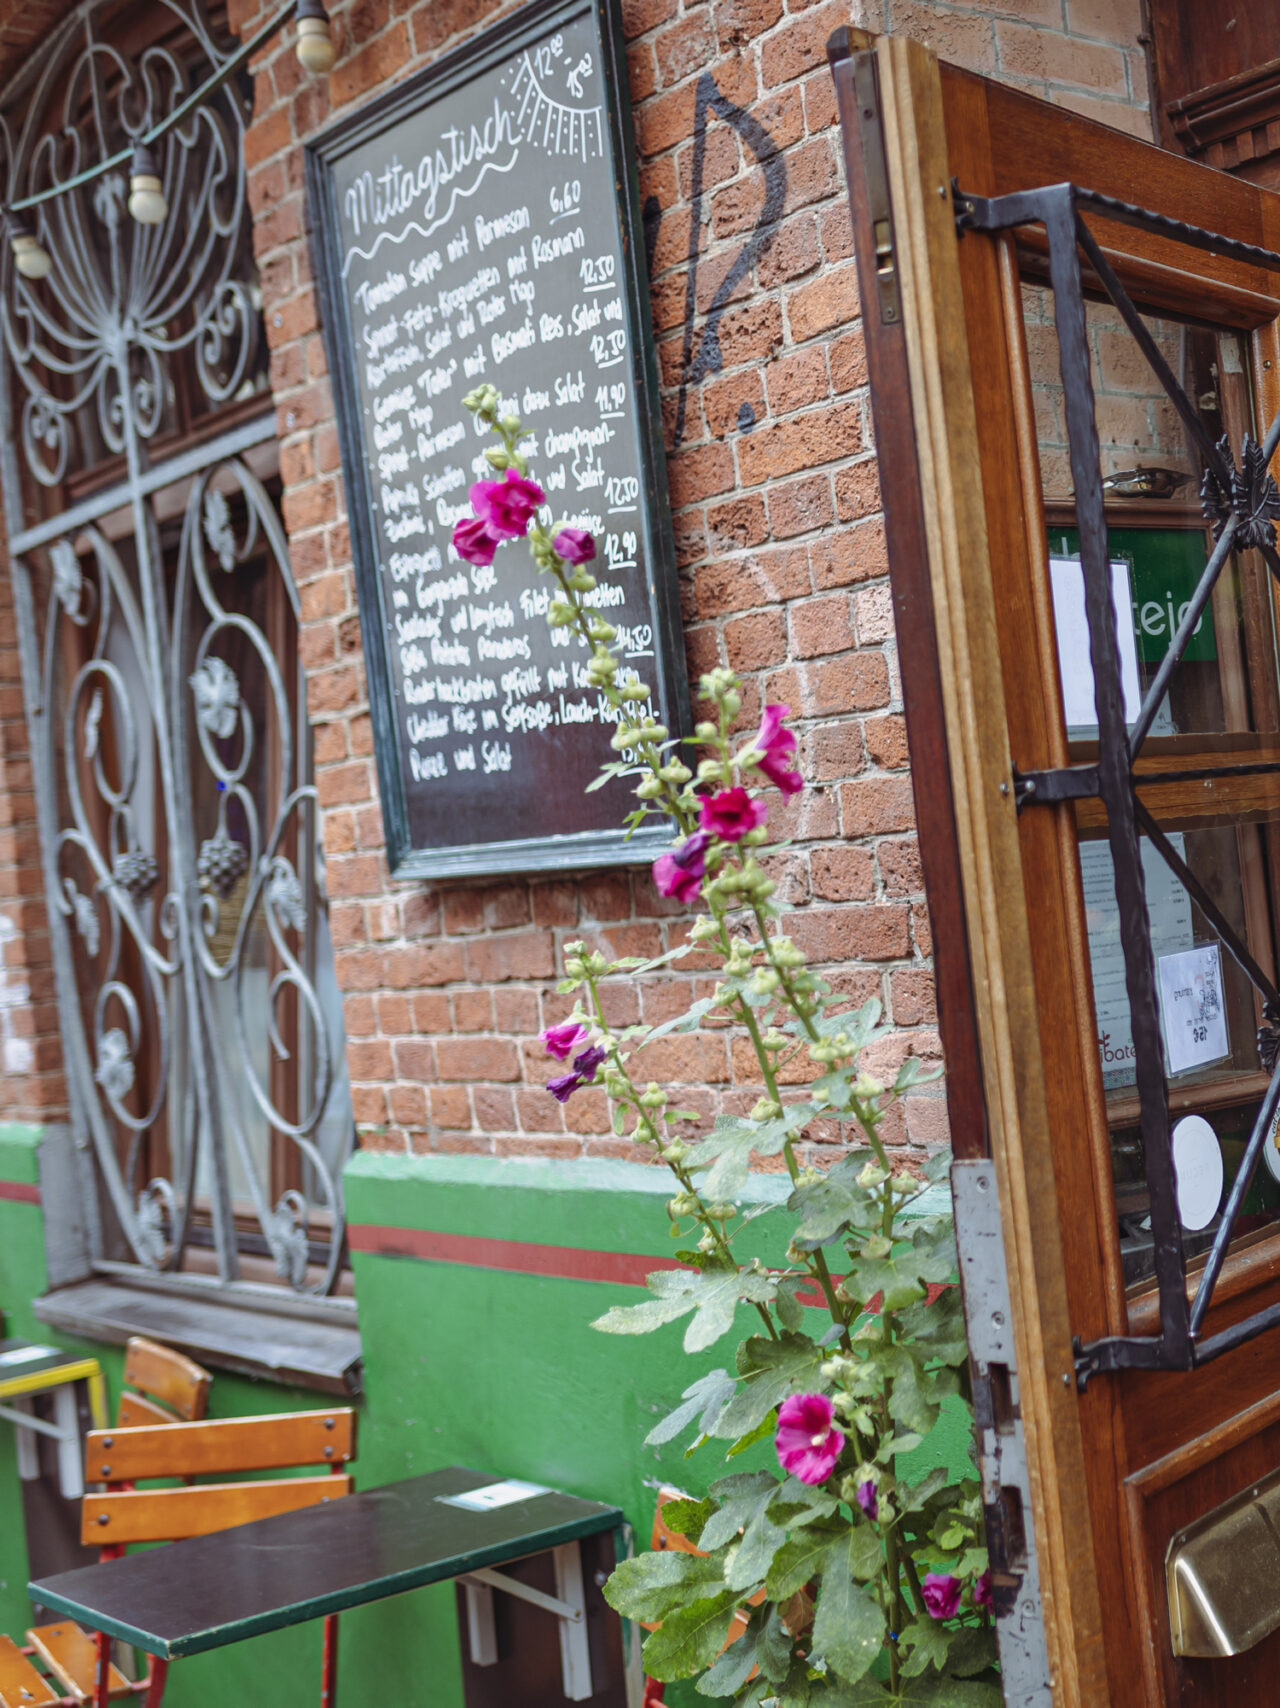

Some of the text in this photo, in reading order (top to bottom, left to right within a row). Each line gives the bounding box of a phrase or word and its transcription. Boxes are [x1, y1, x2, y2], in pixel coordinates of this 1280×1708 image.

[345, 96, 522, 236] Mittagstisch
[409, 251, 443, 287] Suppe
[447, 225, 469, 262] mit
[475, 206, 530, 251] Parmesan
[549, 179, 581, 213] 6,60
[507, 245, 527, 279] mit
[457, 311, 475, 339] und
[579, 254, 615, 285] 12,50
[463, 343, 487, 378] mit
[491, 317, 536, 364] Basmati
[571, 297, 602, 336] Salat
[603, 296, 623, 321] und
[589, 328, 626, 363] 12,50
[554, 369, 586, 406] Salat
[594, 382, 626, 413] 11,90
[546, 463, 566, 491] und
[571, 456, 605, 492] Salat
[603, 531, 638, 564] 12,90
[519, 586, 550, 620] Filet
[547, 661, 569, 693] mit
[453, 742, 477, 772] und
[481, 739, 513, 775] Salat
